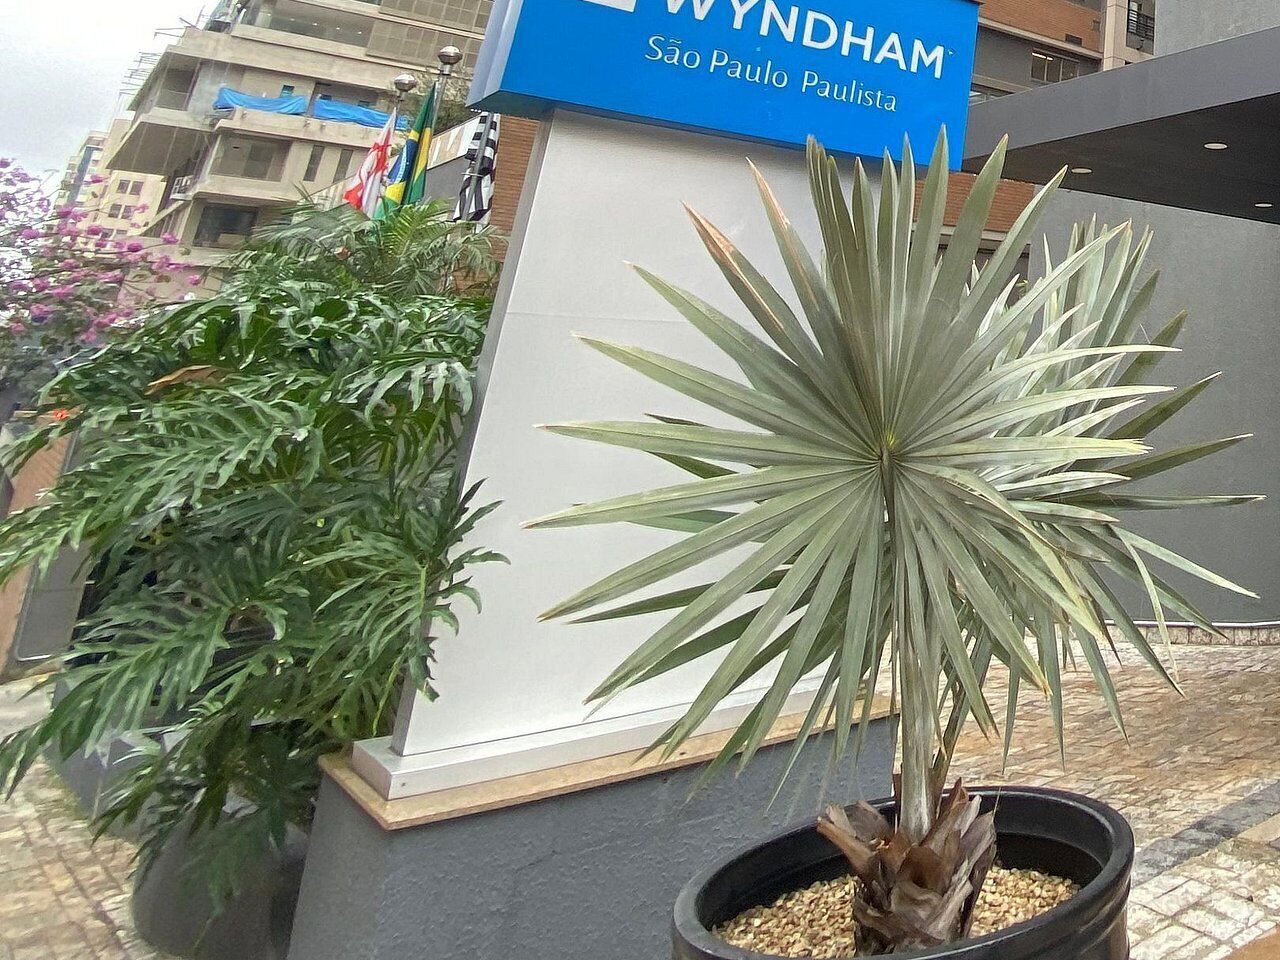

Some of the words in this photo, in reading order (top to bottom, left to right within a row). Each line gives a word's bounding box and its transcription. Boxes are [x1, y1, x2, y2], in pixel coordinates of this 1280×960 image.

[645, 35, 702, 69] São
[709, 49, 788, 89] Paulo
[801, 70, 897, 112] Paulista
